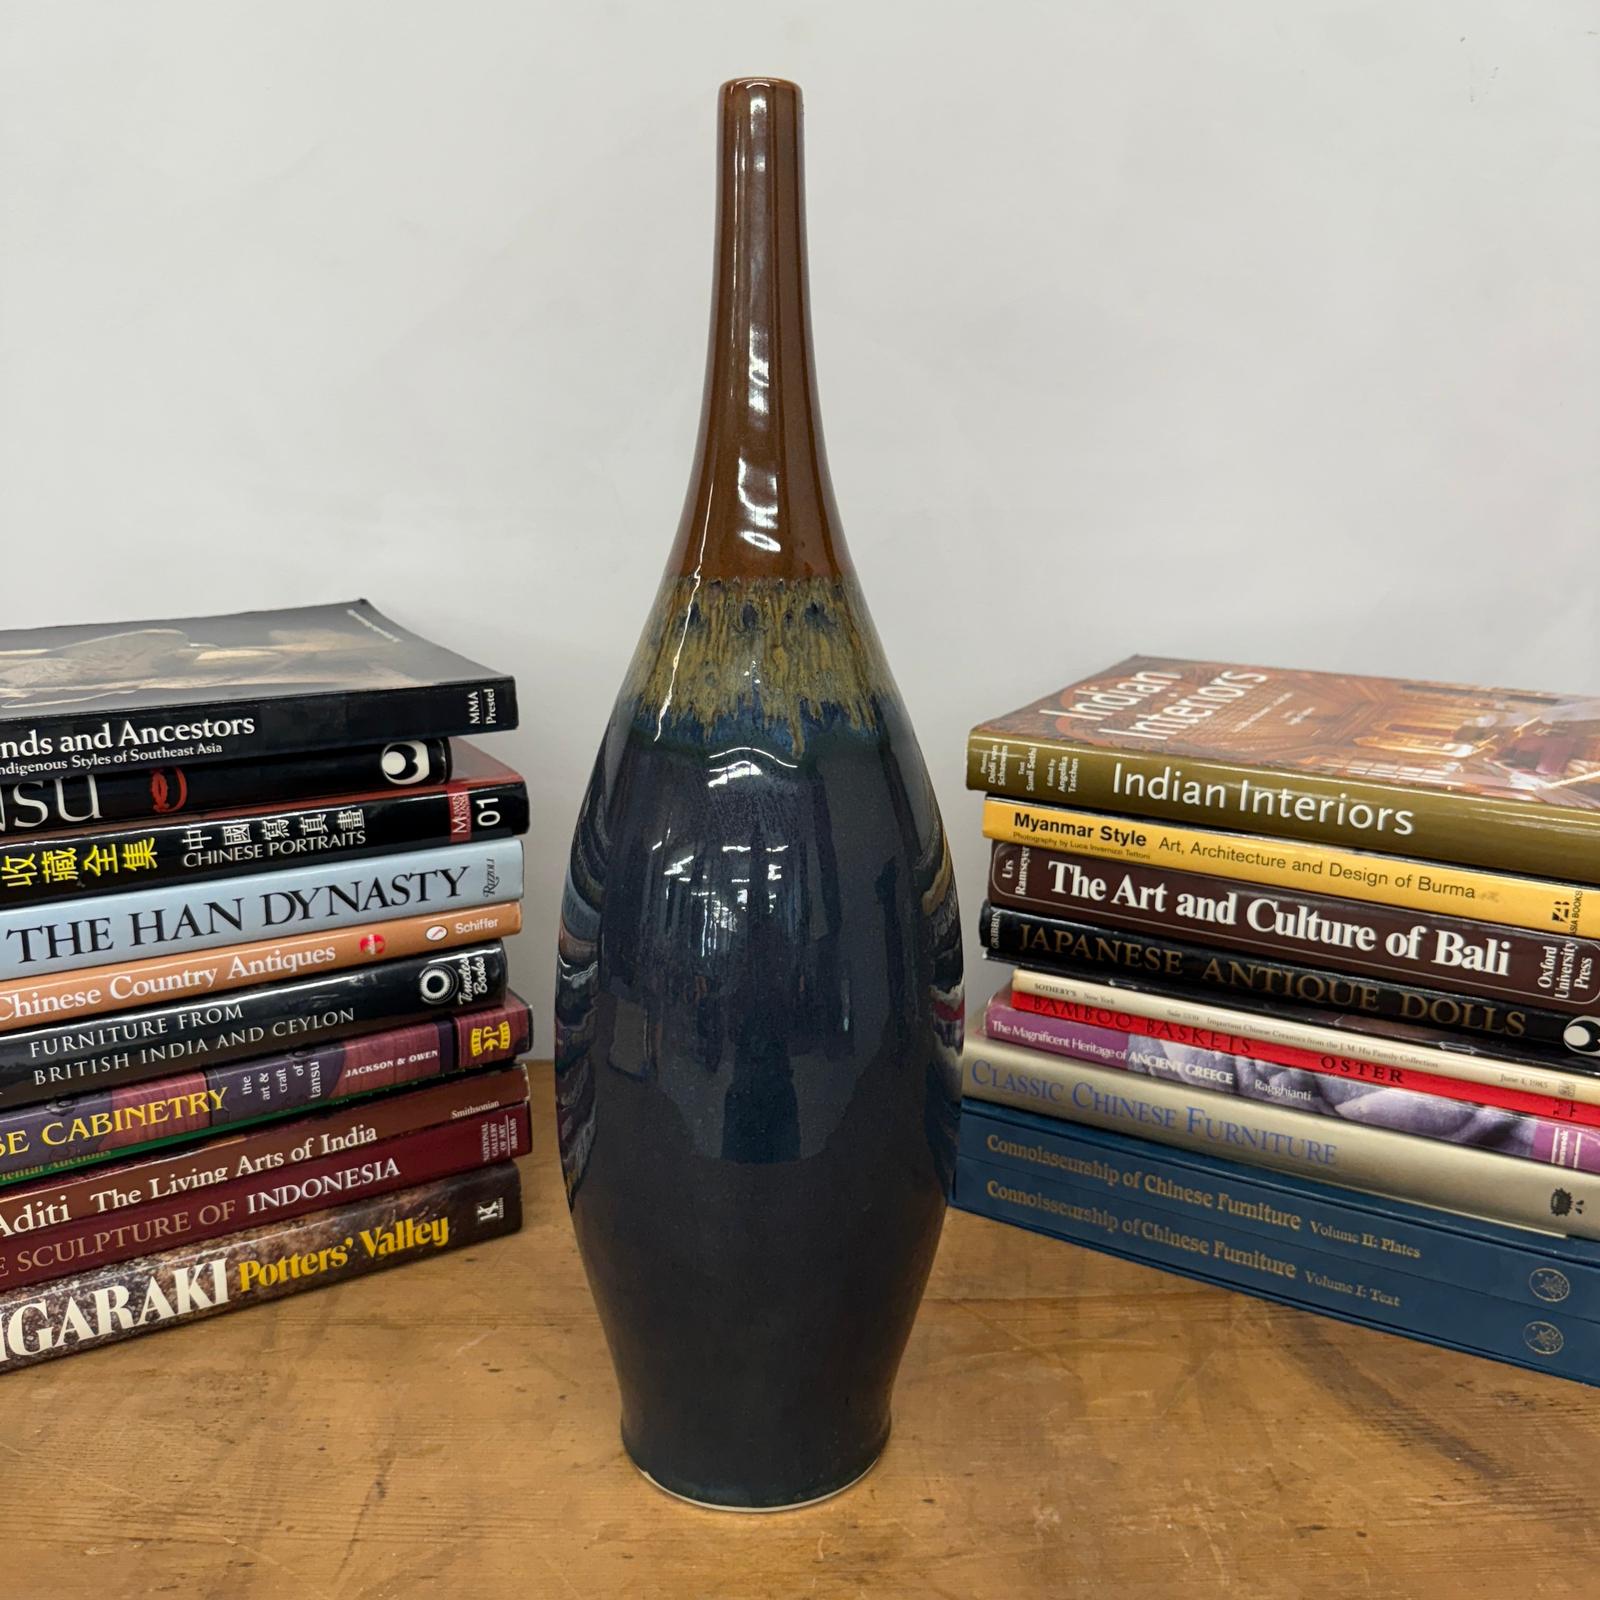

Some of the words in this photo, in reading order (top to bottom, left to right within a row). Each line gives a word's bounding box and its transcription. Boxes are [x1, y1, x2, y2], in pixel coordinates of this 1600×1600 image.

[469, 691, 481, 724] MMA
[483, 688, 497, 724] Prestel
[1039, 670, 1183, 721] Indian
[1098, 670, 1268, 740] Interiors
[60, 722, 113, 751] and
[118, 717, 255, 747] Ancestors
[71, 754, 111, 769] Styles
[113, 750, 128, 764] of
[130, 745, 194, 762] Southeast
[197, 743, 223, 755] Asia
[1028, 748, 1037, 771] Sethi
[1058, 756, 1069, 793] Angelika
[1068, 757, 1079, 793] Taschen
[1026, 773, 1035, 791] Sunil
[1113, 762, 1227, 808] Indian
[1239, 779, 1415, 836] Interiors
[476, 797, 501, 827] 01
[1014, 812, 1094, 838] Myanmar
[1100, 825, 1147, 847] Style
[183, 843, 263, 868] CHINESE
[268, 830, 367, 856] PORTRAITS
[1013, 831, 1058, 847] Photography
[1059, 838, 1068, 849] by
[1070, 839, 1089, 850] Luca
[1, 837, 158, 888] 收藏全集
[1002, 859, 1014, 879] Urs
[1015, 846, 1030, 896] Ramseyer
[1159, 837, 1184, 854] Art,
[1190, 841, 1287, 868] Architecture
[1292, 860, 1323, 874] and
[1329, 862, 1388, 888] Design
[1395, 874, 1413, 888] of
[1418, 876, 1476, 900] Burma
[6, 917, 114, 963] THE
[128, 897, 244, 947] HAN
[259, 865, 470, 927] DYNASTY
[1048, 860, 1107, 901] The
[1110, 873, 1168, 913] Art
[1175, 891, 1237, 925] and
[1246, 898, 1376, 951] Culture
[1385, 925, 1427, 960] of
[1431, 929, 1512, 976] Bali
[1571, 890, 1583, 918] BOOKS
[455, 917, 498, 935] Schiffer
[0, 988, 101, 1021] Chinese
[110, 968, 217, 1000] Country
[226, 945, 336, 980] Antiques
[472, 956, 488, 995] Books
[1019, 923, 1183, 974] JAPANESE
[1202, 957, 1380, 1010] ANTIQUE
[1399, 992, 1526, 1037] DOLLS
[1537, 945, 1557, 988] Oxford
[1554, 940, 1578, 1000] University
[1574, 956, 1593, 990] Press
[1034, 982, 1078, 998] SOTHEBY'S
[29, 1017, 169, 1058] FURNITURE
[178, 1004, 244, 1031] FROM
[33, 1053, 130, 1086] BRITISH
[140, 1038, 208, 1065] INDIA
[217, 1026, 264, 1049] AND
[272, 1007, 355, 1038] CEYLON
[1033, 998, 1132, 1029] BAMBOO
[1146, 1020, 1250, 1053] BASKETS
[1321, 1056, 1403, 1083] OSTER
[292, 1063, 304, 1077] of
[344, 1059, 394, 1079] JACKSON
[397, 1056, 406, 1065] &
[409, 1049, 438, 1064] OWEN
[992, 1020, 1011, 1034] The
[1012, 1025, 1070, 1047] Magnificent
[1071, 1037, 1115, 1058] Heritage
[1115, 1049, 1127, 1060] of
[1128, 1051, 1183, 1072] ANCIENT
[1185, 1063, 1234, 1085] GREECE
[242, 1075, 254, 1096] the
[259, 1072, 270, 1084] &
[262, 1085, 271, 1101] art
[276, 1067, 288, 1093] craft
[309, 1061, 321, 1099] tansu
[1255, 1079, 1312, 1101] Ragghianti
[41, 1086, 228, 1146] CABINETRY
[451, 1100, 500, 1120] Smithsonian
[972, 1059, 1064, 1100] CLASSIC
[1072, 1082, 1177, 1128] CHINESE
[1186, 1106, 1337, 1165] FURNITURE
[480, 1121, 489, 1162] NATIONAL
[490, 1122, 498, 1157] GALLERY
[0, 1194, 72, 1238] Aditi
[90, 1188, 142, 1213] The
[149, 1167, 228, 1198] Living
[236, 1150, 284, 1178] Arts
[290, 1137, 314, 1162] of
[321, 1123, 379, 1155] India
[987, 1134, 1119, 1186] Connoisseurship
[1122, 1171, 1142, 1188] of
[1144, 1175, 1213, 1208] Chinese
[1217, 1191, 1302, 1230] Furniture
[17, 1211, 192, 1273] SCULPTURE
[198, 1199, 236, 1226] OF
[247, 1157, 401, 1215] INDONESIA
[987, 1180, 1118, 1232] Connoisseurship
[1122, 1219, 1141, 1234] of
[1141, 1222, 1209, 1254] Chinese
[1213, 1239, 1297, 1279] Furniture
[239, 1237, 354, 1293] Potters'
[358, 1216, 449, 1259] Valley
[1311, 1220, 1359, 1243] Volume
[1380, 1237, 1421, 1259] Plates
[1305, 1270, 1353, 1295] Volume
[1370, 1287, 1400, 1307] Text
